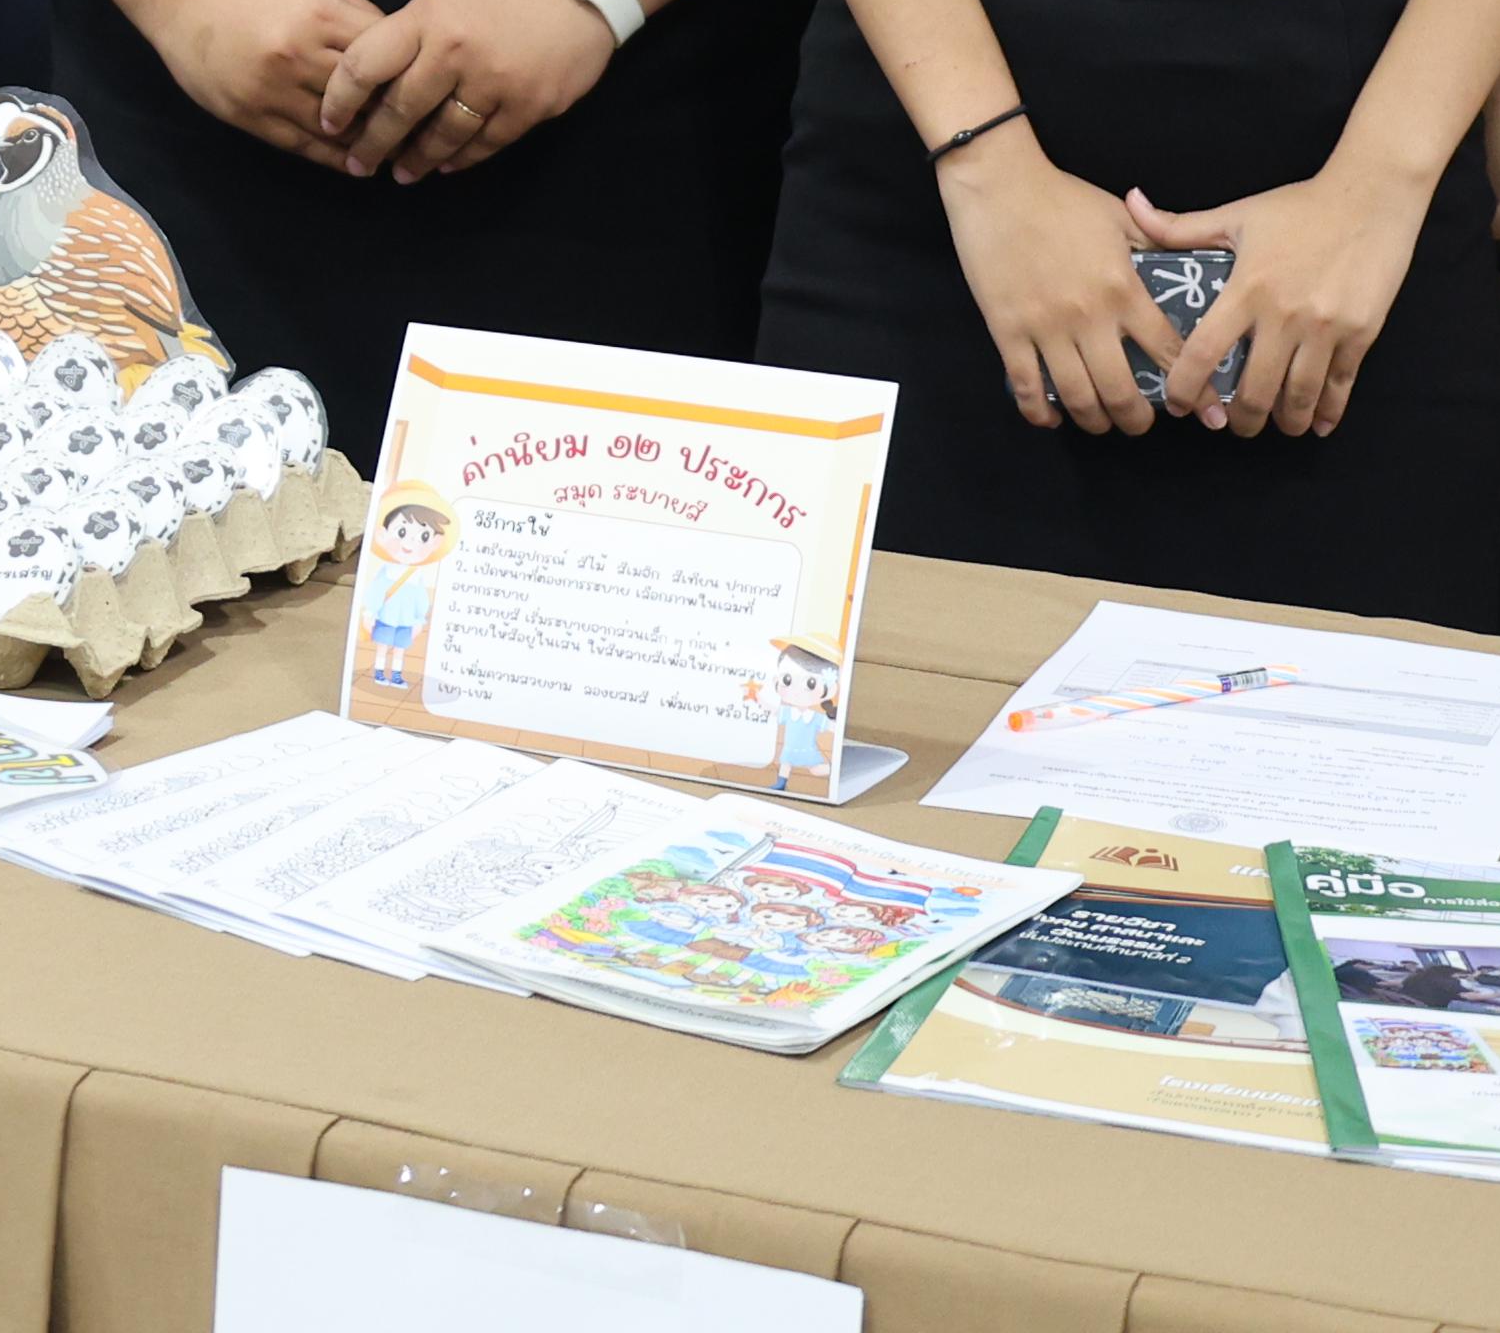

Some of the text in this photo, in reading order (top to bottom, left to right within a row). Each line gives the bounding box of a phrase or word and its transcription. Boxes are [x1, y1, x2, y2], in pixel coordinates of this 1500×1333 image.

[462, 432, 807, 529] ค่านิยม ๑๒ ประการ
[553, 483, 708, 521] สมุด ระบายสี
[1305, 868, 1426, 899] คู่มือ
[1071, 908, 1177, 933] รายวิชา
